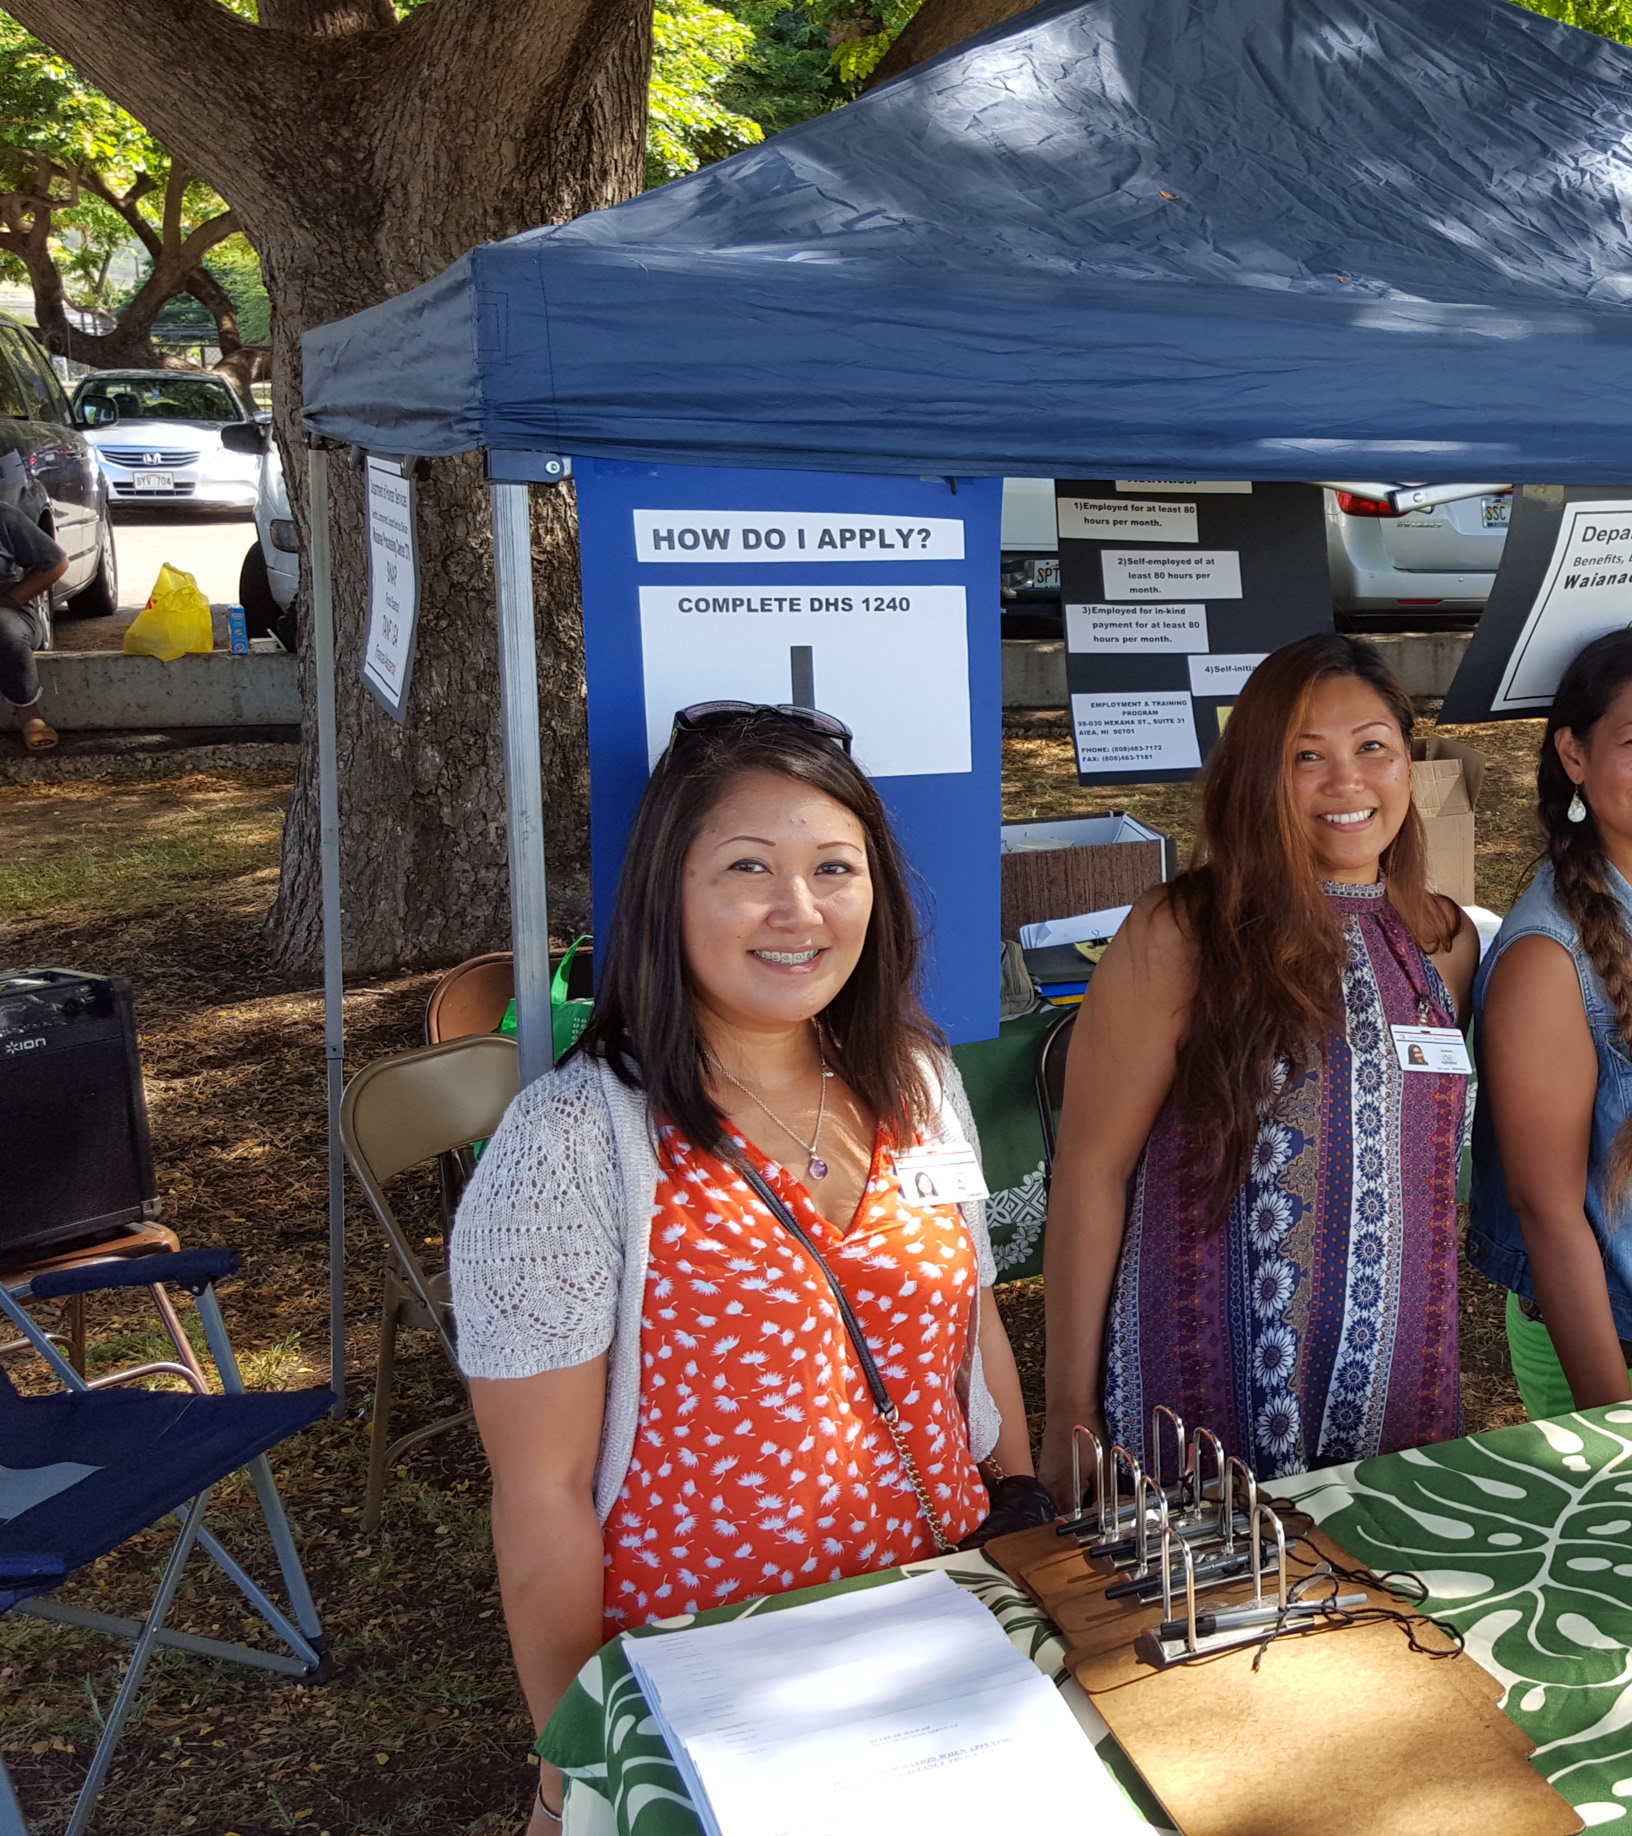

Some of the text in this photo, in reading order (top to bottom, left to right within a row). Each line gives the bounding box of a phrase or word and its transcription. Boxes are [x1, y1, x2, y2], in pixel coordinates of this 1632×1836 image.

[1131, 504, 1144, 512] for
[1158, 505, 1181, 513] least
[1486, 506, 1506, 520] SSC
[1084, 517, 1110, 525] hours
[1113, 519, 1128, 527] per
[652, 527, 932, 551] HOW DO I APPLY?
[1118, 558, 1192, 567] 2)Self-employed
[1573, 554, 1625, 567] Benefits,
[1037, 568, 1060, 584] SPT
[678, 596, 910, 613] COMPLETE DHS 1240
[1155, 607, 1186, 615] in-kind
[1092, 622, 1133, 630] payment
[1136, 621, 1148, 629] for
[1163, 621, 1186, 629] least
[1094, 635, 1119, 643] hours
[1122, 636, 1137, 644] per
